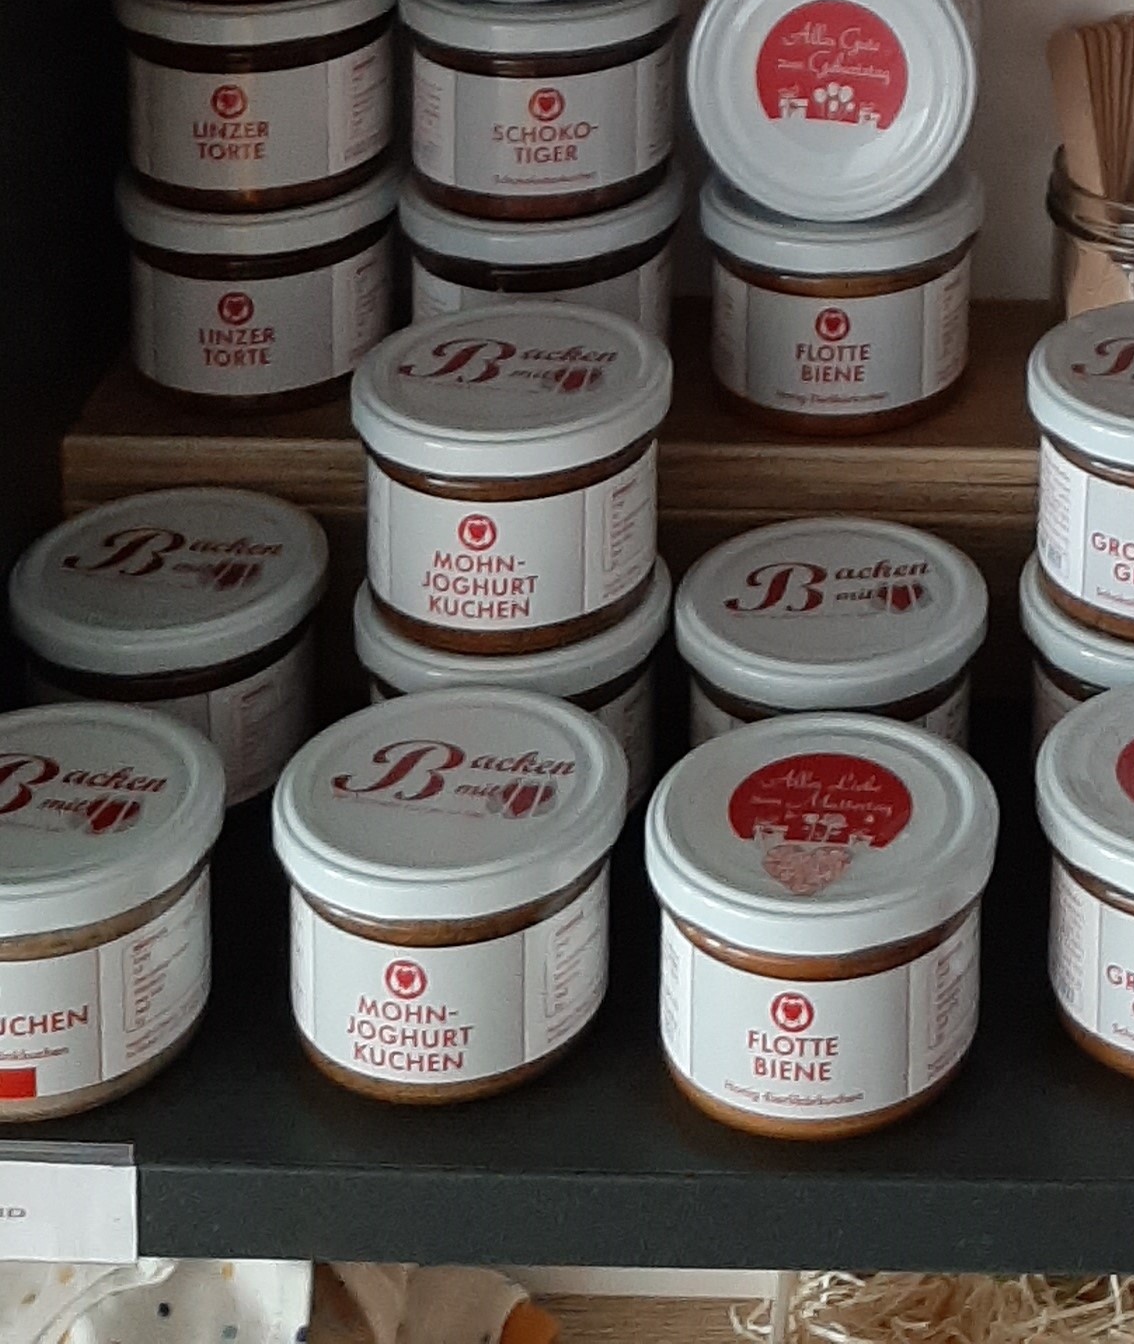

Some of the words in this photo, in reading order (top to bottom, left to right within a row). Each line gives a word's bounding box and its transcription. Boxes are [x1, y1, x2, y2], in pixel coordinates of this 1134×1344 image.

[193, 120, 270, 140] LINZER
[492, 120, 600, 146] SCHOKO-
[196, 142, 266, 161] TORTE
[513, 145, 579, 166] TIGER
[199, 326, 276, 347] LINZER
[202, 347, 272, 367] TORTE
[399, 338, 619, 385] Backen
[795, 342, 872, 364] FLOTTE
[799, 364, 866, 385] BIENE
[62, 527, 283, 577] Backen
[433, 550, 526, 575] MOHN-
[421, 572, 539, 597] JOGHURT
[723, 560, 930, 612] Backen
[429, 595, 531, 620] KUCHEN
[332, 739, 576, 801] Backen
[358, 994, 459, 1025] MOHN-
[347, 1015, 474, 1048] JOGHURT
[747, 1029, 839, 1058] FLOTTE
[353, 1042, 465, 1074] KUCHEN
[753, 1056, 833, 1082] BIENE
